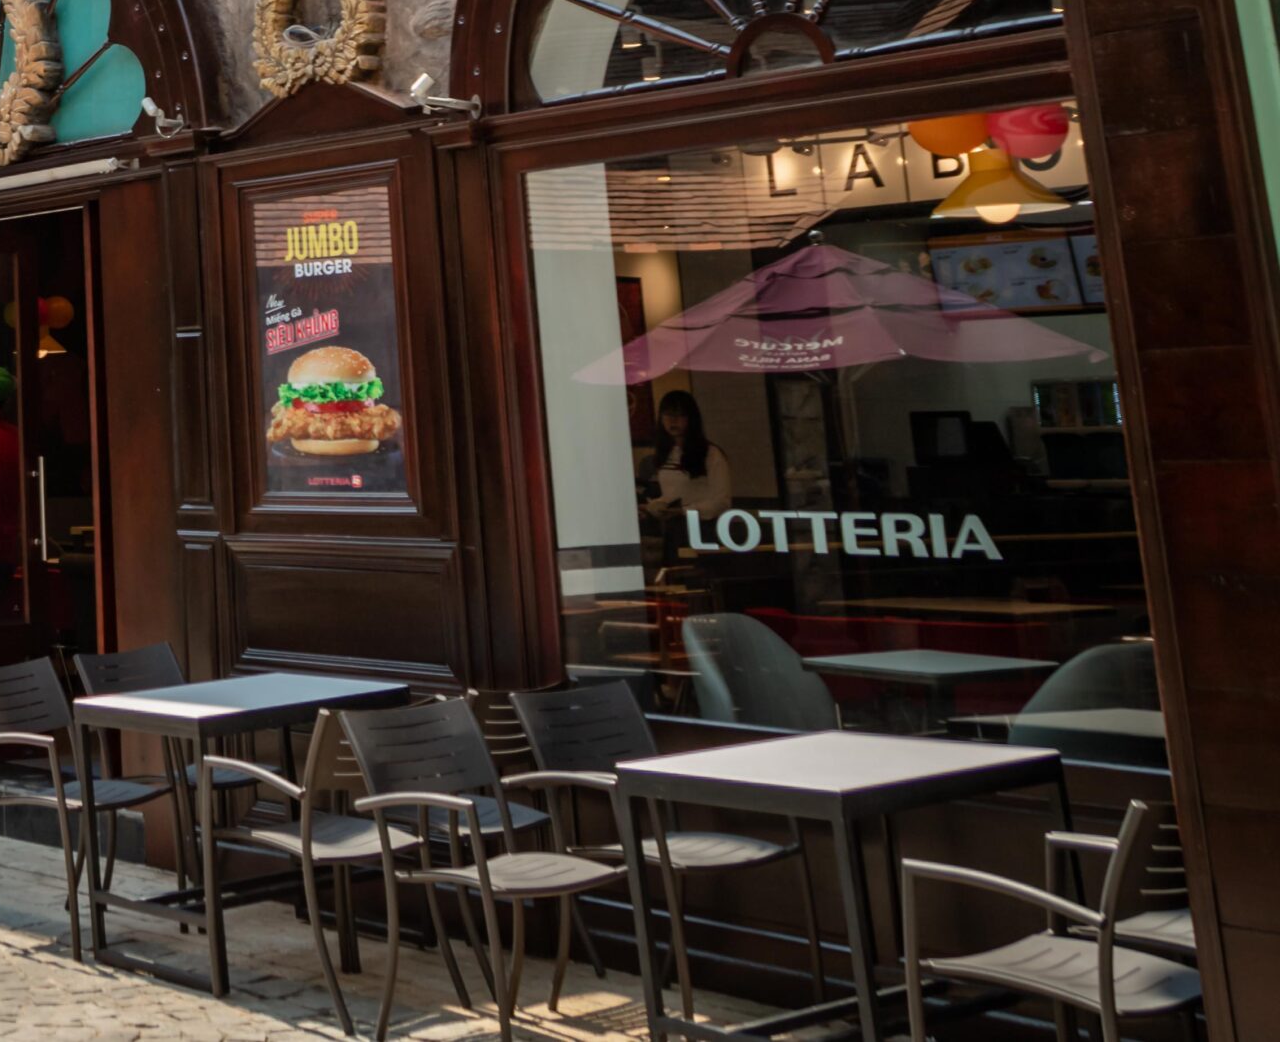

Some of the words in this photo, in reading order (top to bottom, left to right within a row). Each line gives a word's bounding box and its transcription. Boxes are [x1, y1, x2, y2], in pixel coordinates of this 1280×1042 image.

[284, 220, 359, 262] JUMBO
[294, 258, 352, 278] BURGER
[686, 509, 1004, 561] LOTTERIA
